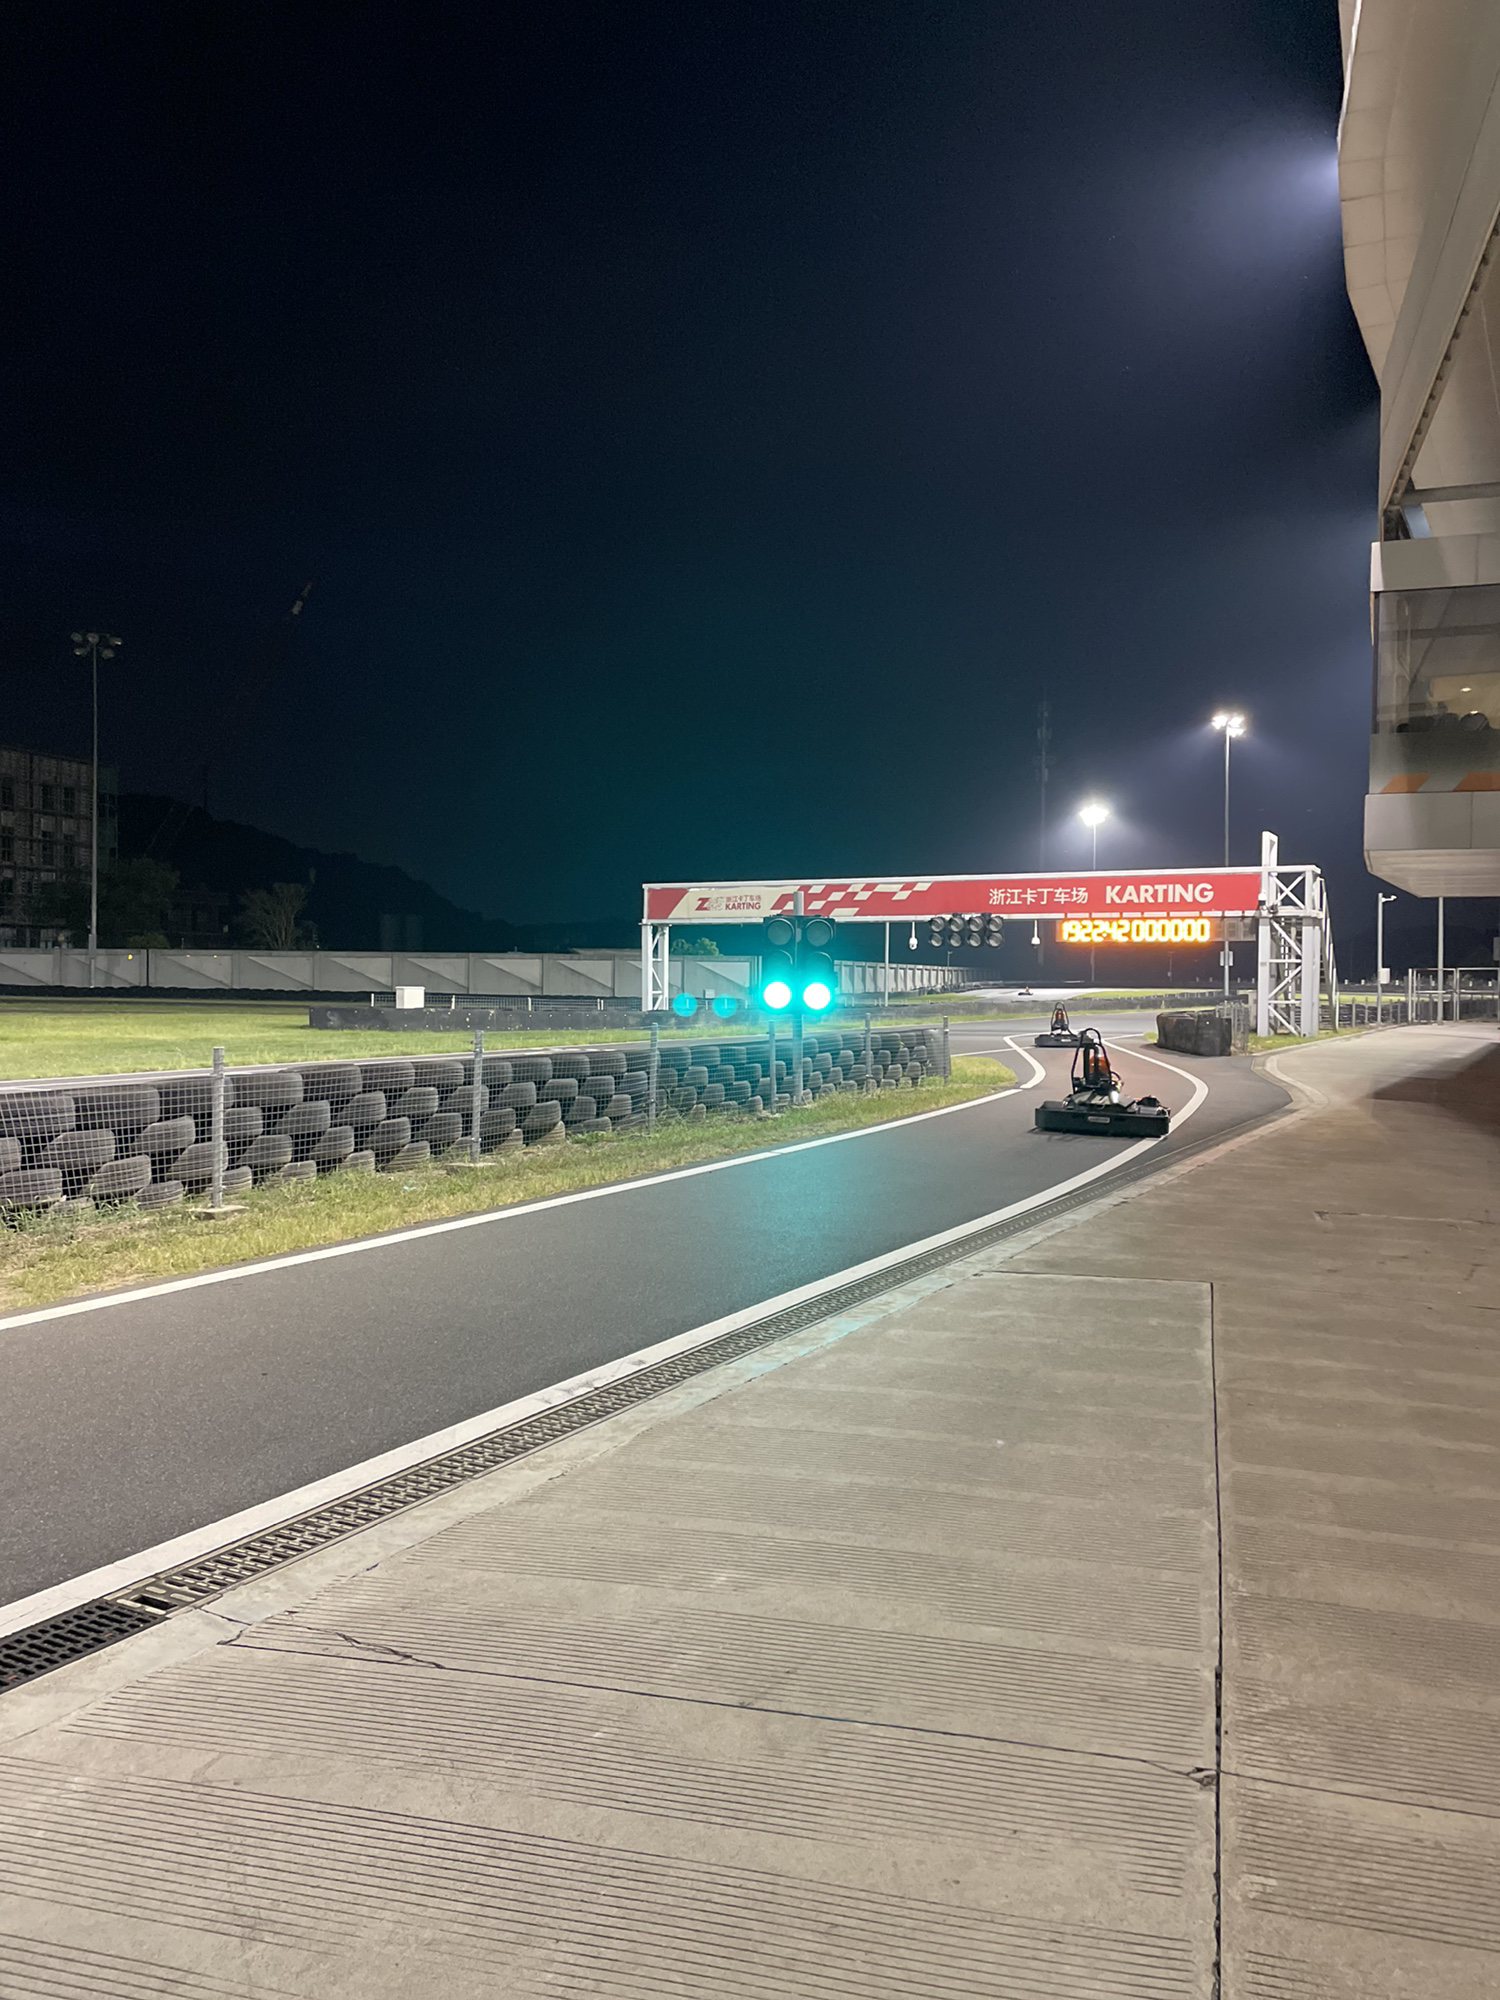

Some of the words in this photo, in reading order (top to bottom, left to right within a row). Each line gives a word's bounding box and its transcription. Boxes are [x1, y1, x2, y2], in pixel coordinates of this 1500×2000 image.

[989, 887, 1088, 905] 浙江卡丁车场
[1105, 883, 1214, 904] KARTING
[725, 902, 761, 911] KARTING
